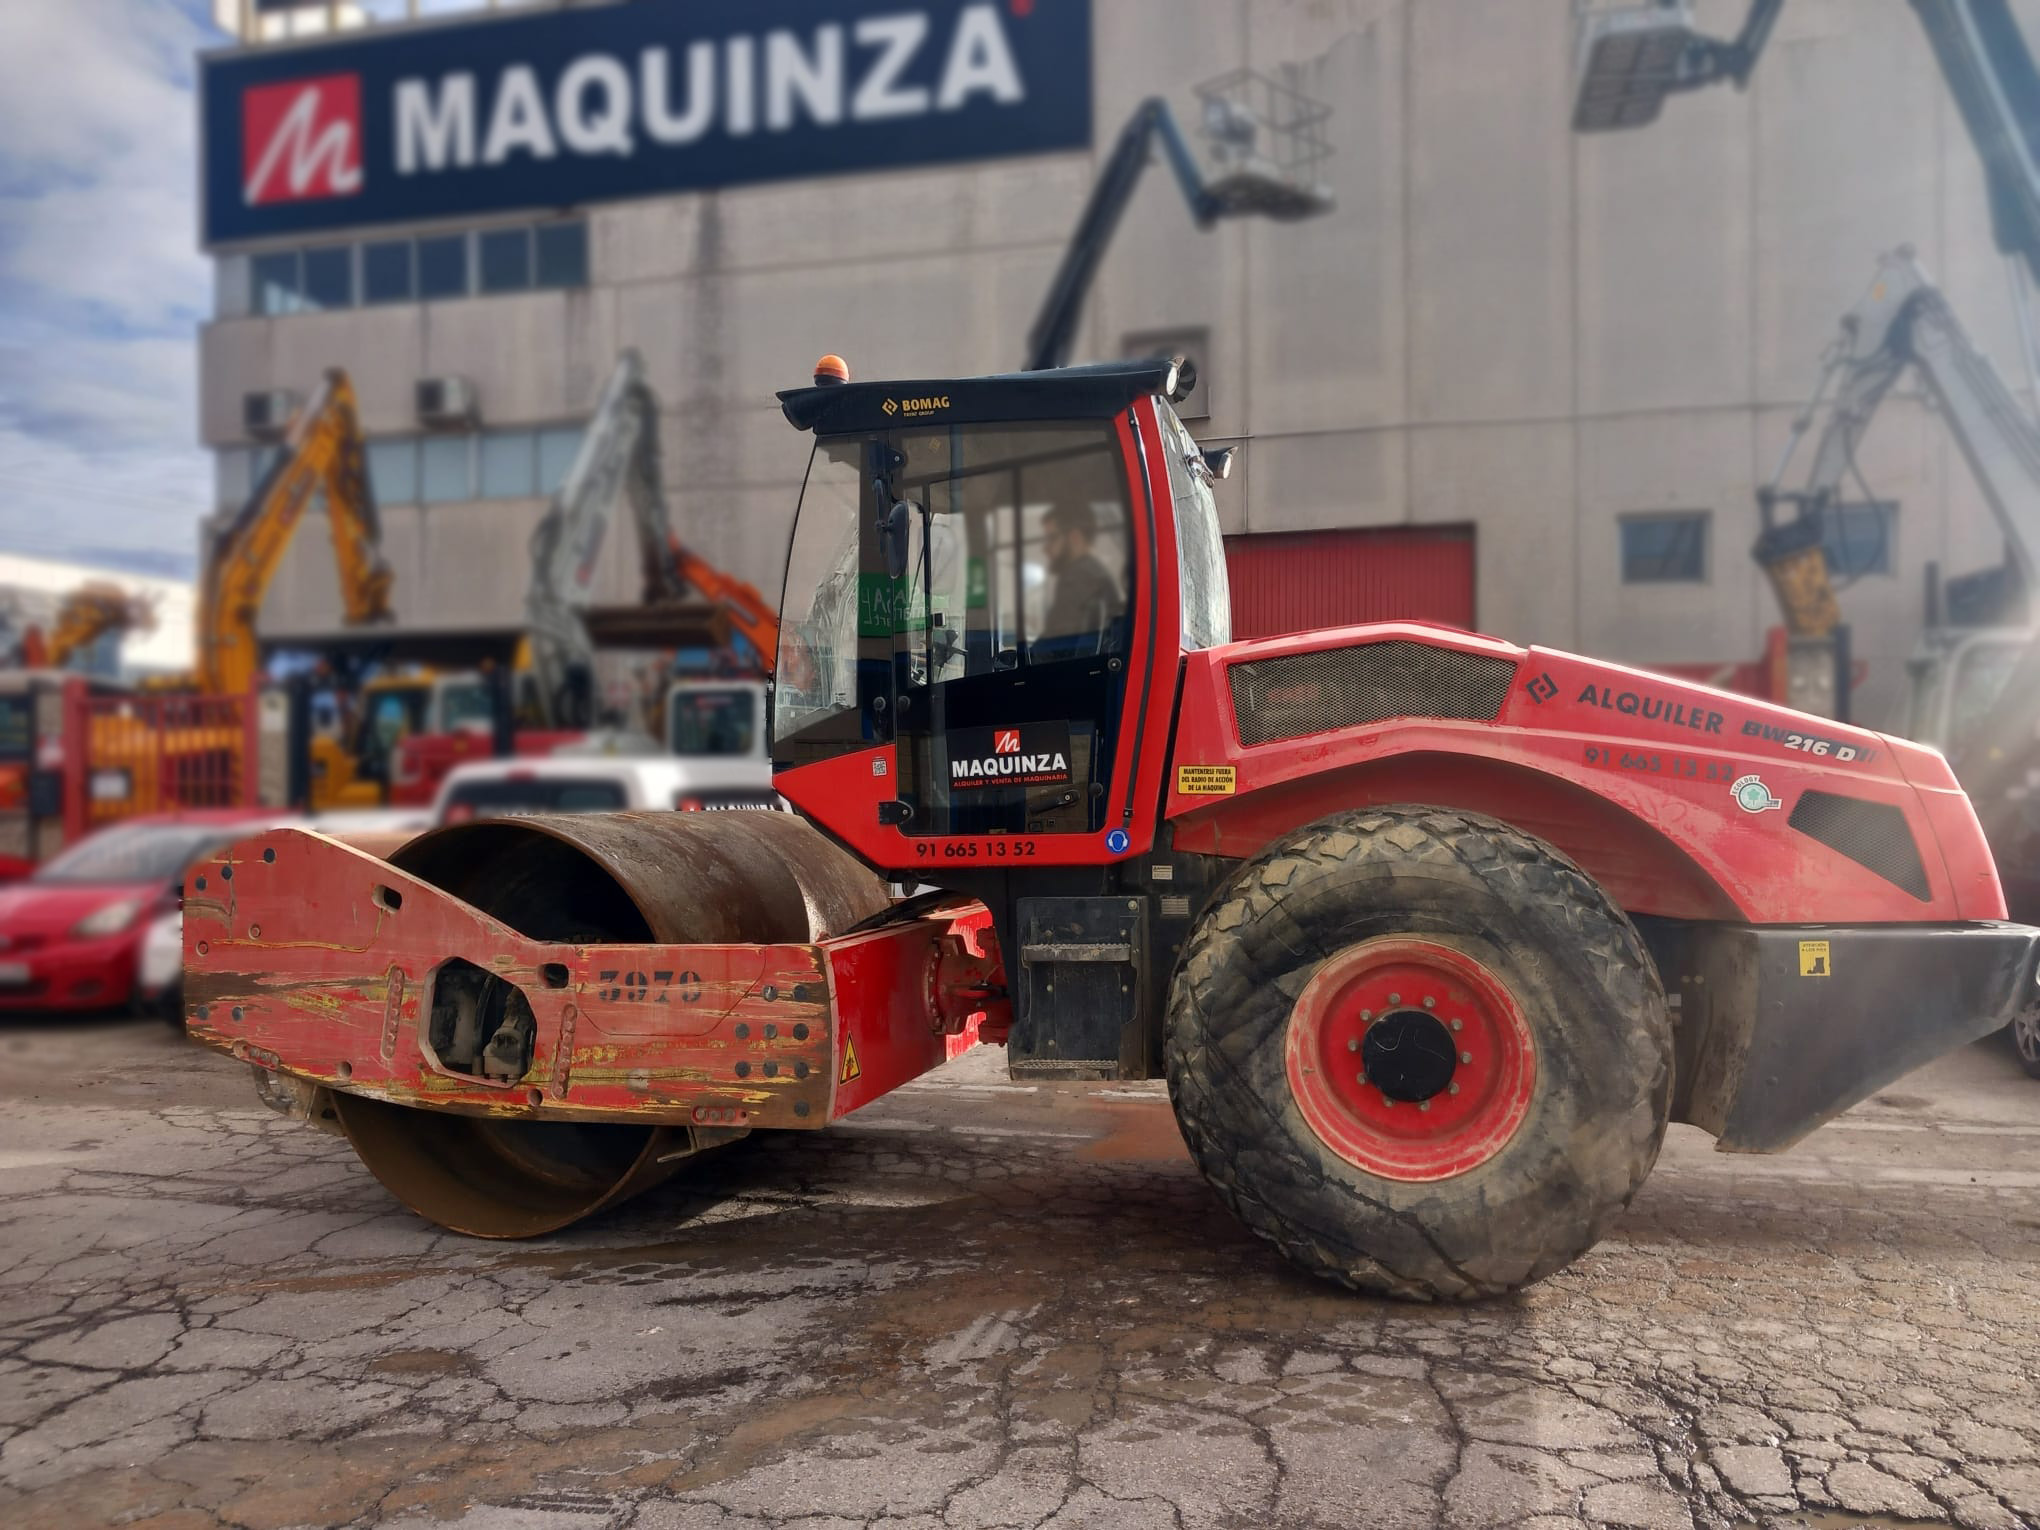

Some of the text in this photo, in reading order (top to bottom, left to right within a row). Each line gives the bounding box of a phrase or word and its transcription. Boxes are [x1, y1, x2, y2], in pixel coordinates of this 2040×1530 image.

[394, 4, 1025, 174] MAQUINZA
[902, 396, 950, 411] BOMAG
[1577, 684, 1724, 734] ALQUILER
[1784, 735, 1831, 756] 216
[952, 753, 1067, 777] MAQUINZA
[1586, 747, 1733, 781] 91 665 13 52
[1024, 773, 1067, 783] MAQUINARIA
[1731, 776, 1758, 795] ECOLOGY
[916, 841, 1035, 857] 91 665 13 52
